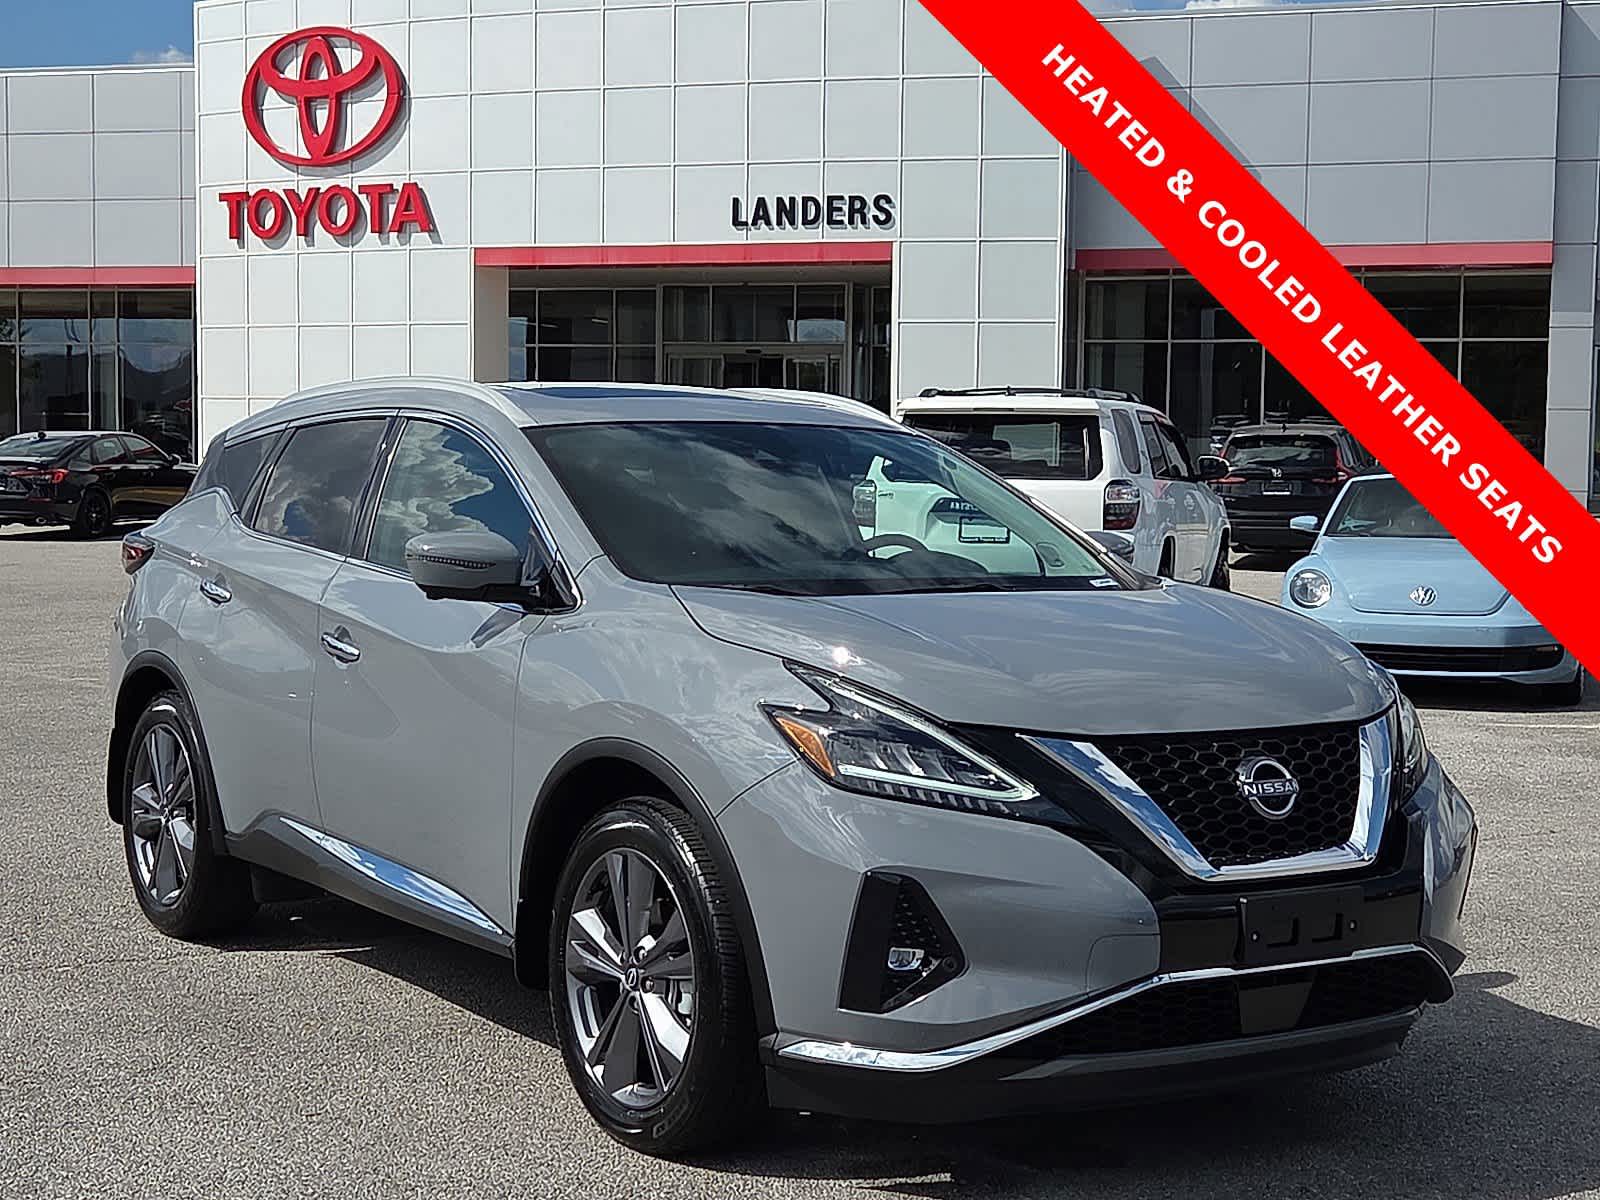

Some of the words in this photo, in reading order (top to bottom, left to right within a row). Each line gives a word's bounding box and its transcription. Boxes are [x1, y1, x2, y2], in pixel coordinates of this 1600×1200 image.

[219, 182, 433, 239] TOYOTA
[731, 194, 893, 228] LANDERS
[1243, 781, 1299, 796] NISSAN
